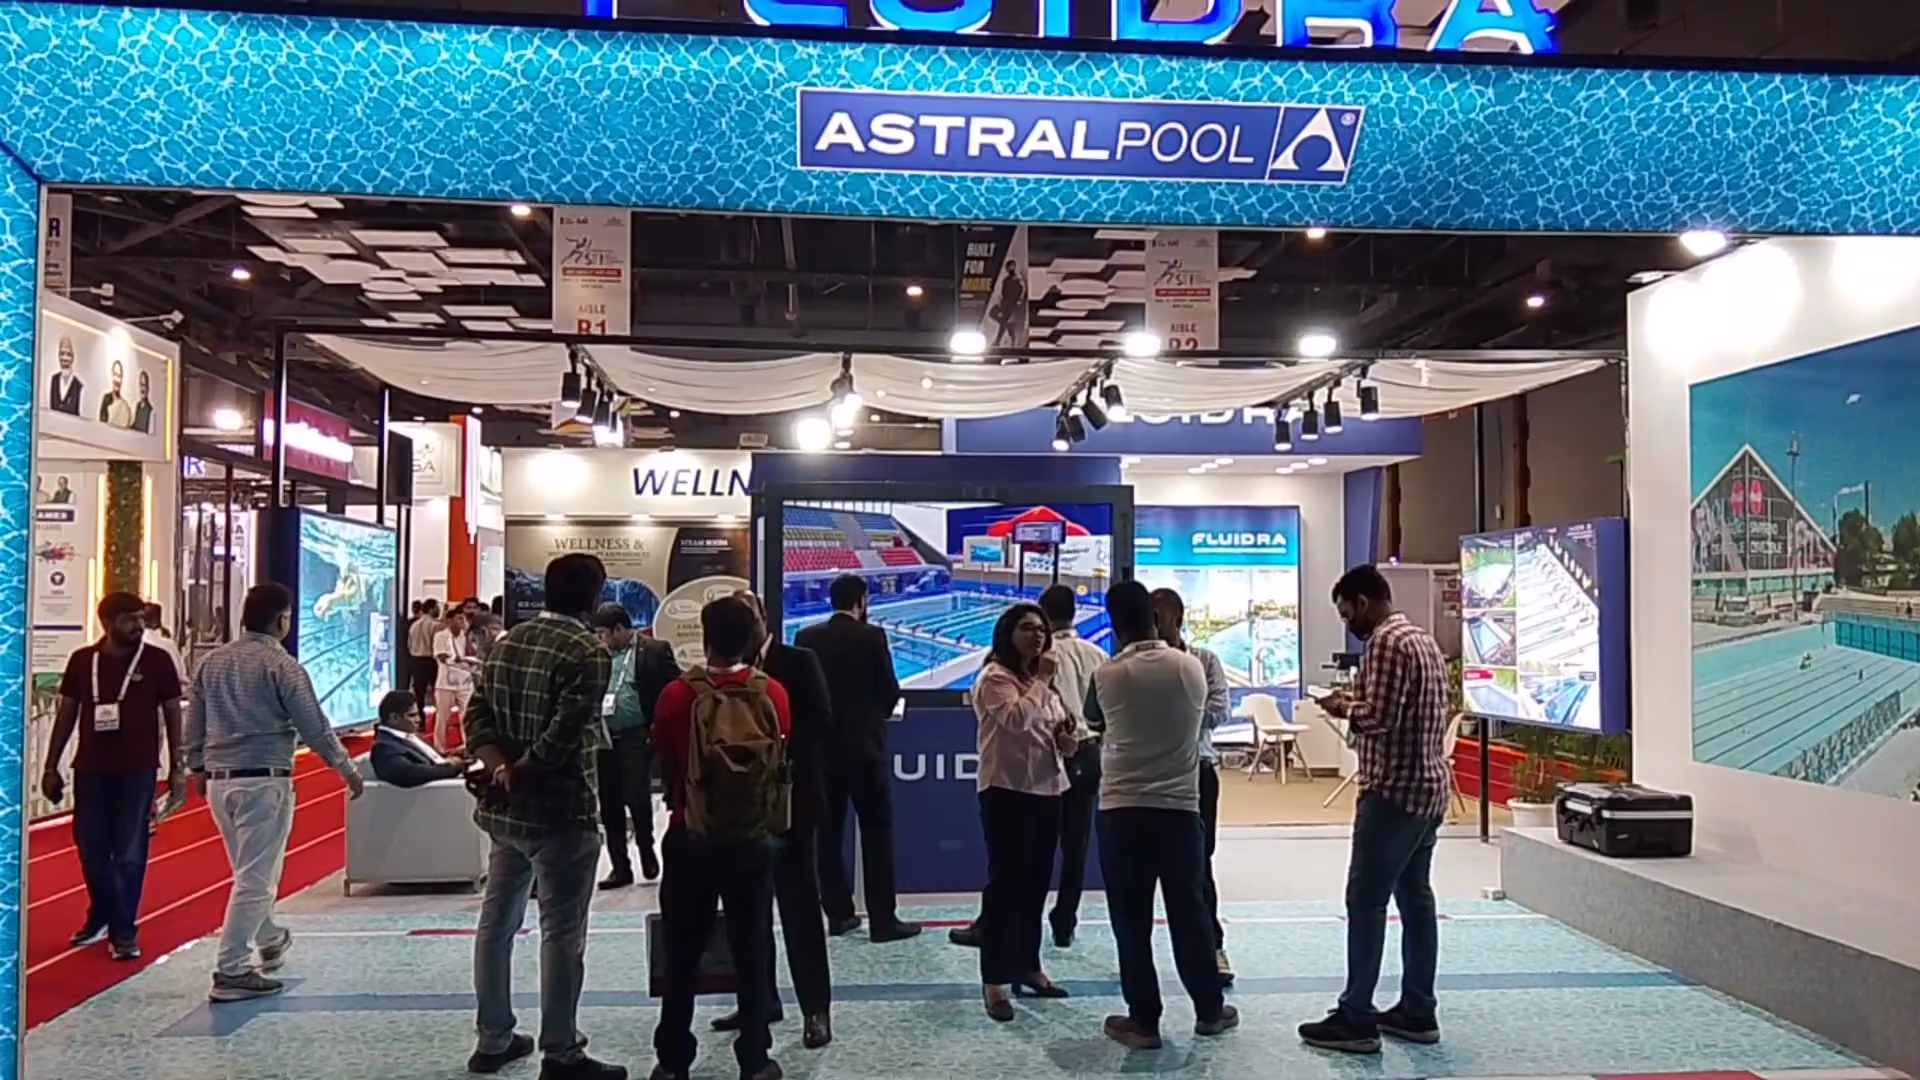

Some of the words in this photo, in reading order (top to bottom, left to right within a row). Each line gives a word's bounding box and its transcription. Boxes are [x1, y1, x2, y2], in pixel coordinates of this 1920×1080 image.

[815, 112, 1254, 163] ASTRALPOOL
[966, 243, 996, 257] BUILT
[963, 260, 985, 275] FOR
[961, 278, 993, 292] MORE
[578, 304, 606, 314] AISLE
[554, 538, 630, 550] WELLNESS
[1192, 532, 1287, 546] FLUIDRA
